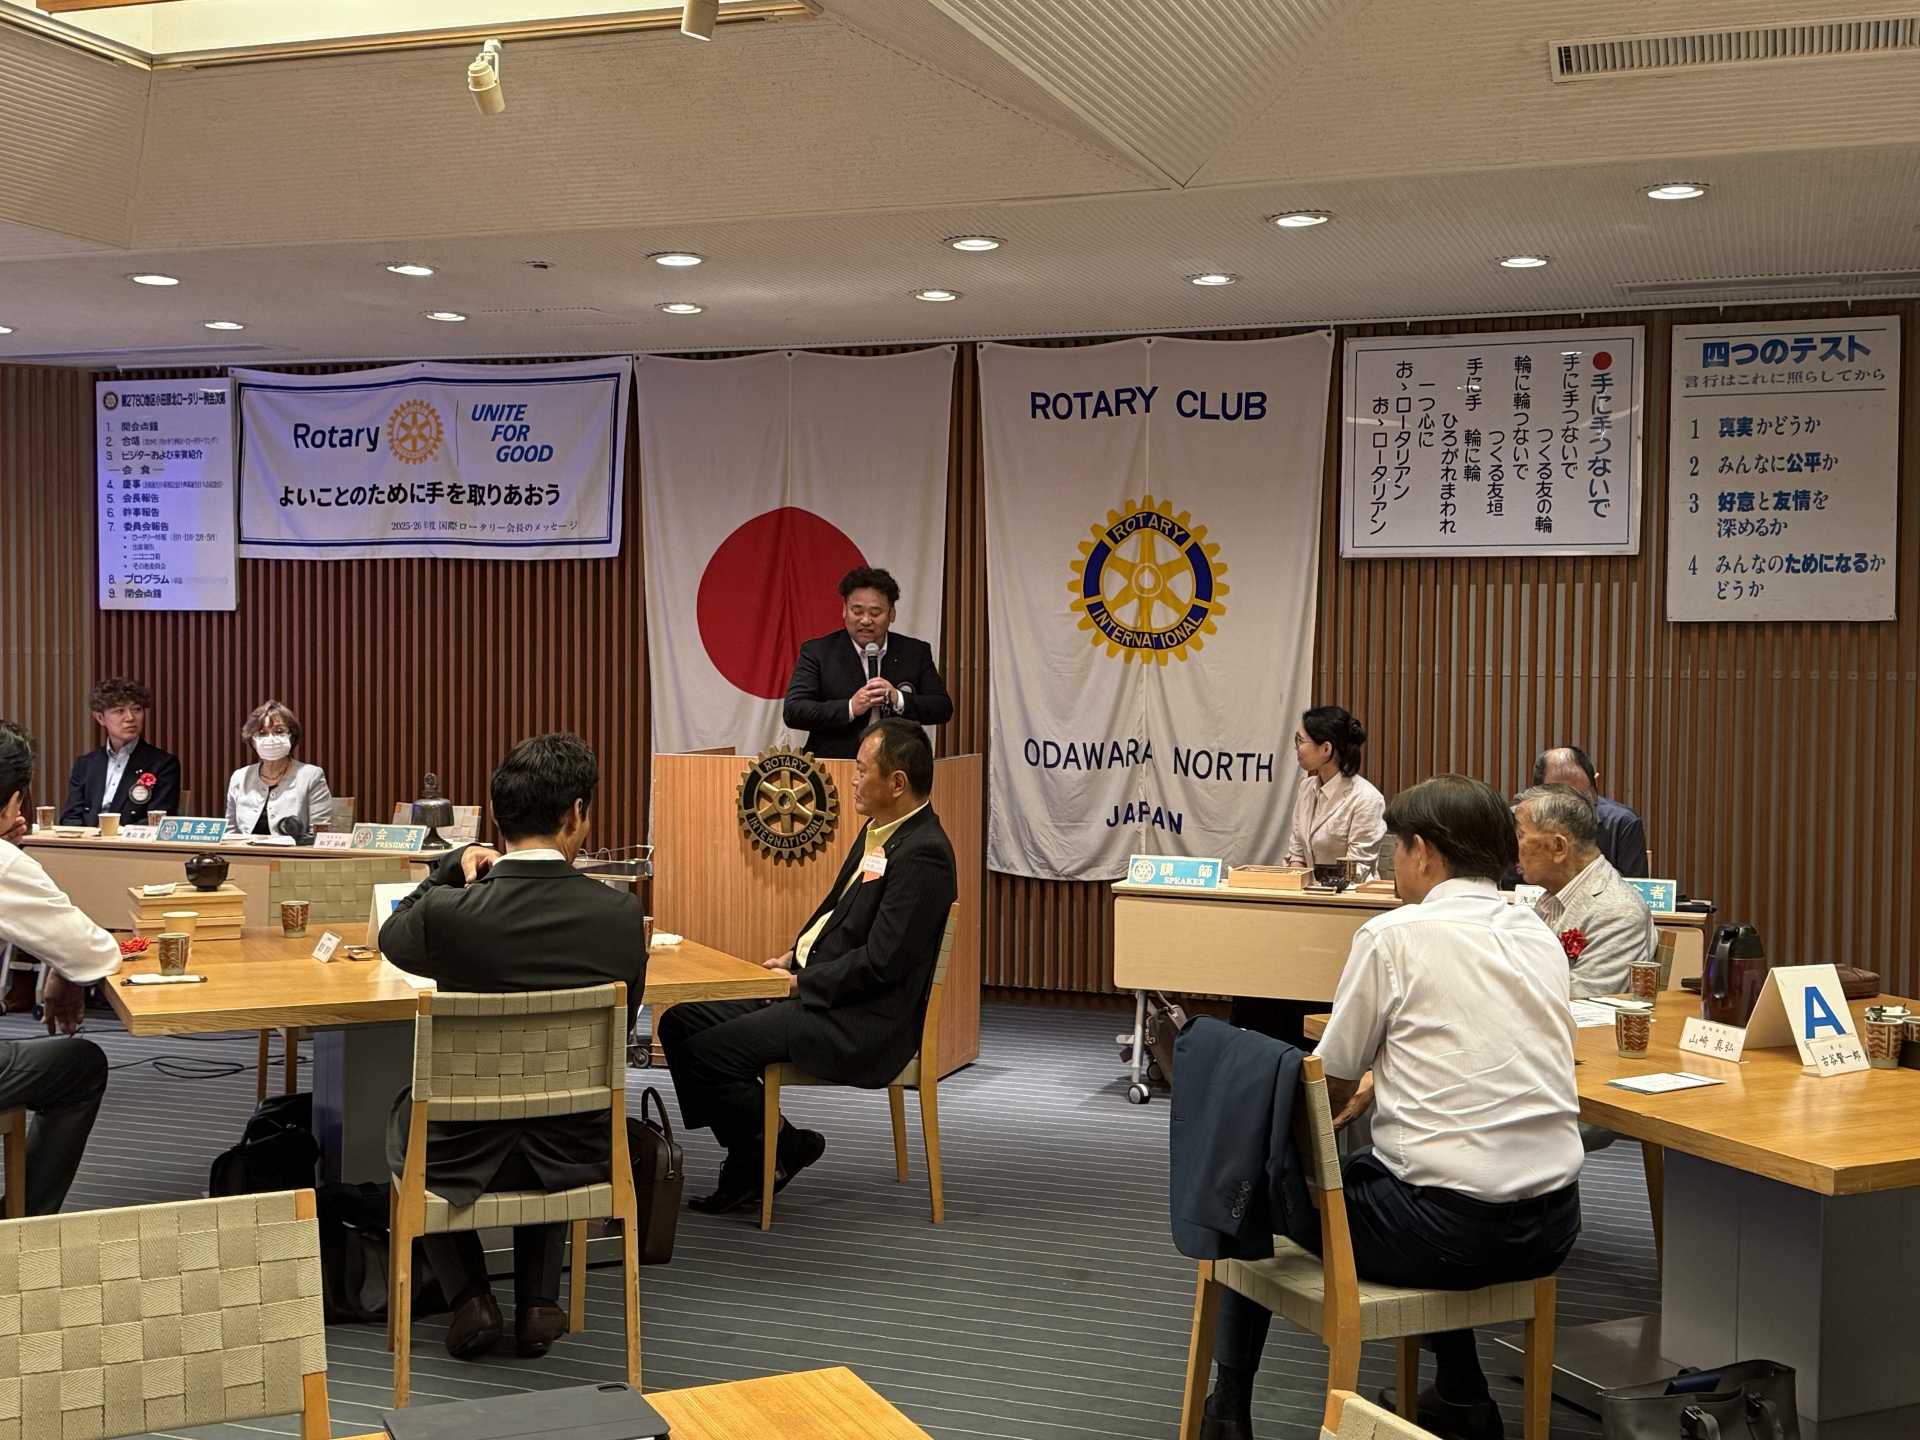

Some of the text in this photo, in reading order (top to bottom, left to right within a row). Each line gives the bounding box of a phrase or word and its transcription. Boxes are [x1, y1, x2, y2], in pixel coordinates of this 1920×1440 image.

[1702, 335, 1871, 368] 四つのテスト
[1684, 368, 1886, 389] 言行はこれに照らしてから
[471, 403, 528, 423] UNITE
[1030, 386, 1267, 421] ROTARY CLUB
[1418, 383, 1435, 448] 一つ心に
[1513, 355, 1532, 480] 輪に輪つないで
[1561, 353, 1580, 480] 手に手つないで
[491, 424, 531, 442] FOR
[1464, 357, 1483, 482] 手に手 輪に輪
[1691, 416, 1821, 439] 1 真実かどうか
[293, 422, 380, 452] Rotary
[1588, 372, 1614, 519] 手に手つないで
[495, 444, 554, 463] GOOD
[1690, 452, 1838, 476] 2 みんなに公平か
[1439, 413, 1458, 534] ひろがれまわれ
[1486, 430, 1505, 516] つくる友垣
[1535, 429, 1553, 533] つくる友の輪
[123, 493, 160, 503] 会長報告
[279, 481, 561, 507] よいことのために手を取りあおう
[1689, 490, 1829, 513] 3 好意と友情を
[1112, 512, 1185, 541] ROTARY
[1717, 518, 1788, 538] 深めるか
[1688, 552, 1886, 575] 4 みんなのためになるか
[124, 573, 170, 585] プログラム
[1716, 580, 1764, 600] どうか
[1091, 607, 1203, 648] INTERNATIONAL
[763, 756, 808, 772] ROTARY
[1024, 737, 1275, 782] ODAWARA NORTH
[748, 816, 823, 848] INTERNATIONAL
[1106, 801, 1183, 835] JAPAN
[1804, 985, 1847, 1040] A
